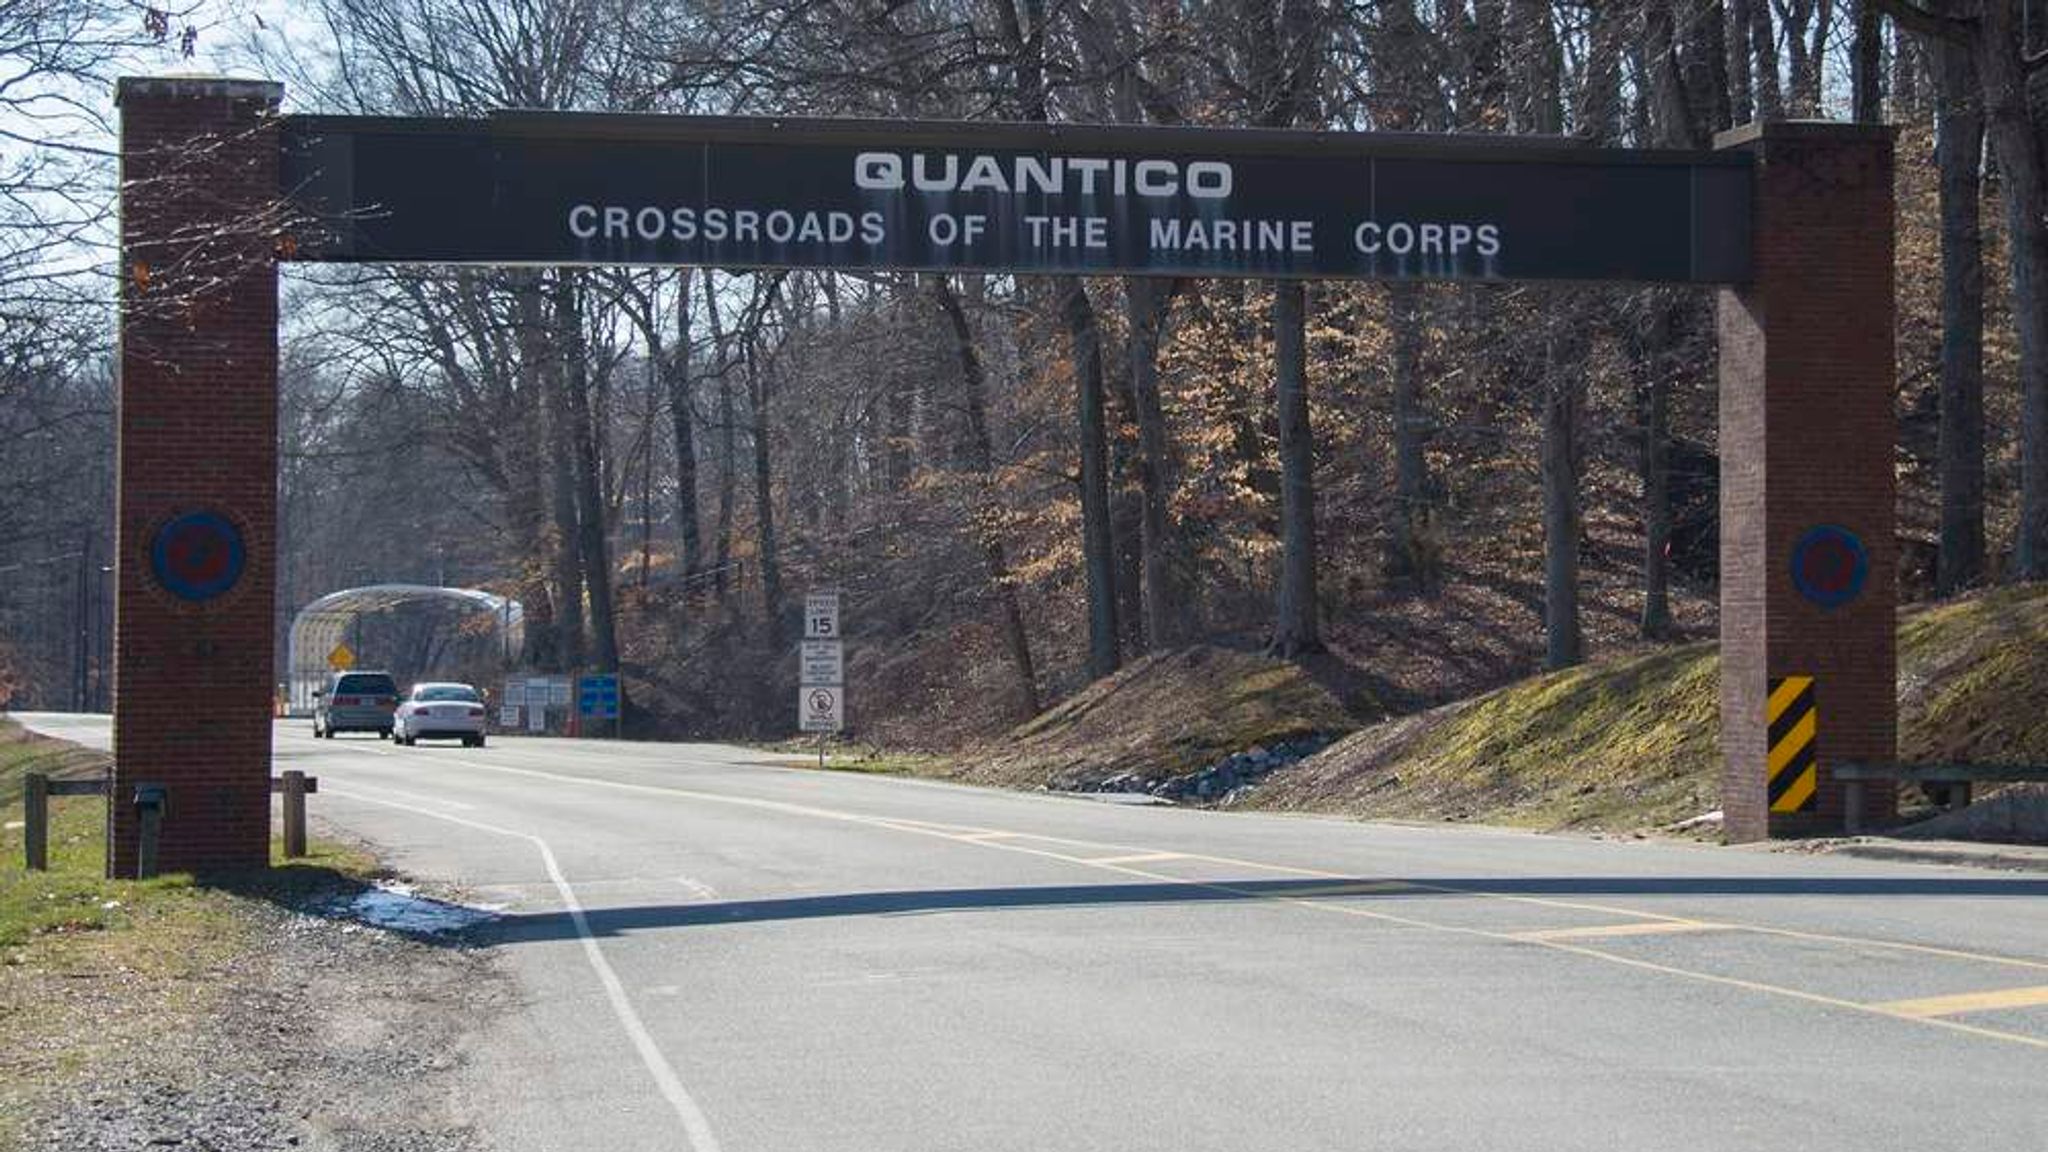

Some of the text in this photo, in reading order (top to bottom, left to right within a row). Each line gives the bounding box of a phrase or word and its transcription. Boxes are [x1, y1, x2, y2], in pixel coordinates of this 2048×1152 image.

[855, 151, 1233, 198] QUANTICO
[569, 204, 1500, 256] CROSSROADS OF THE MARINE CORPS
[812, 617, 833, 634] 15
